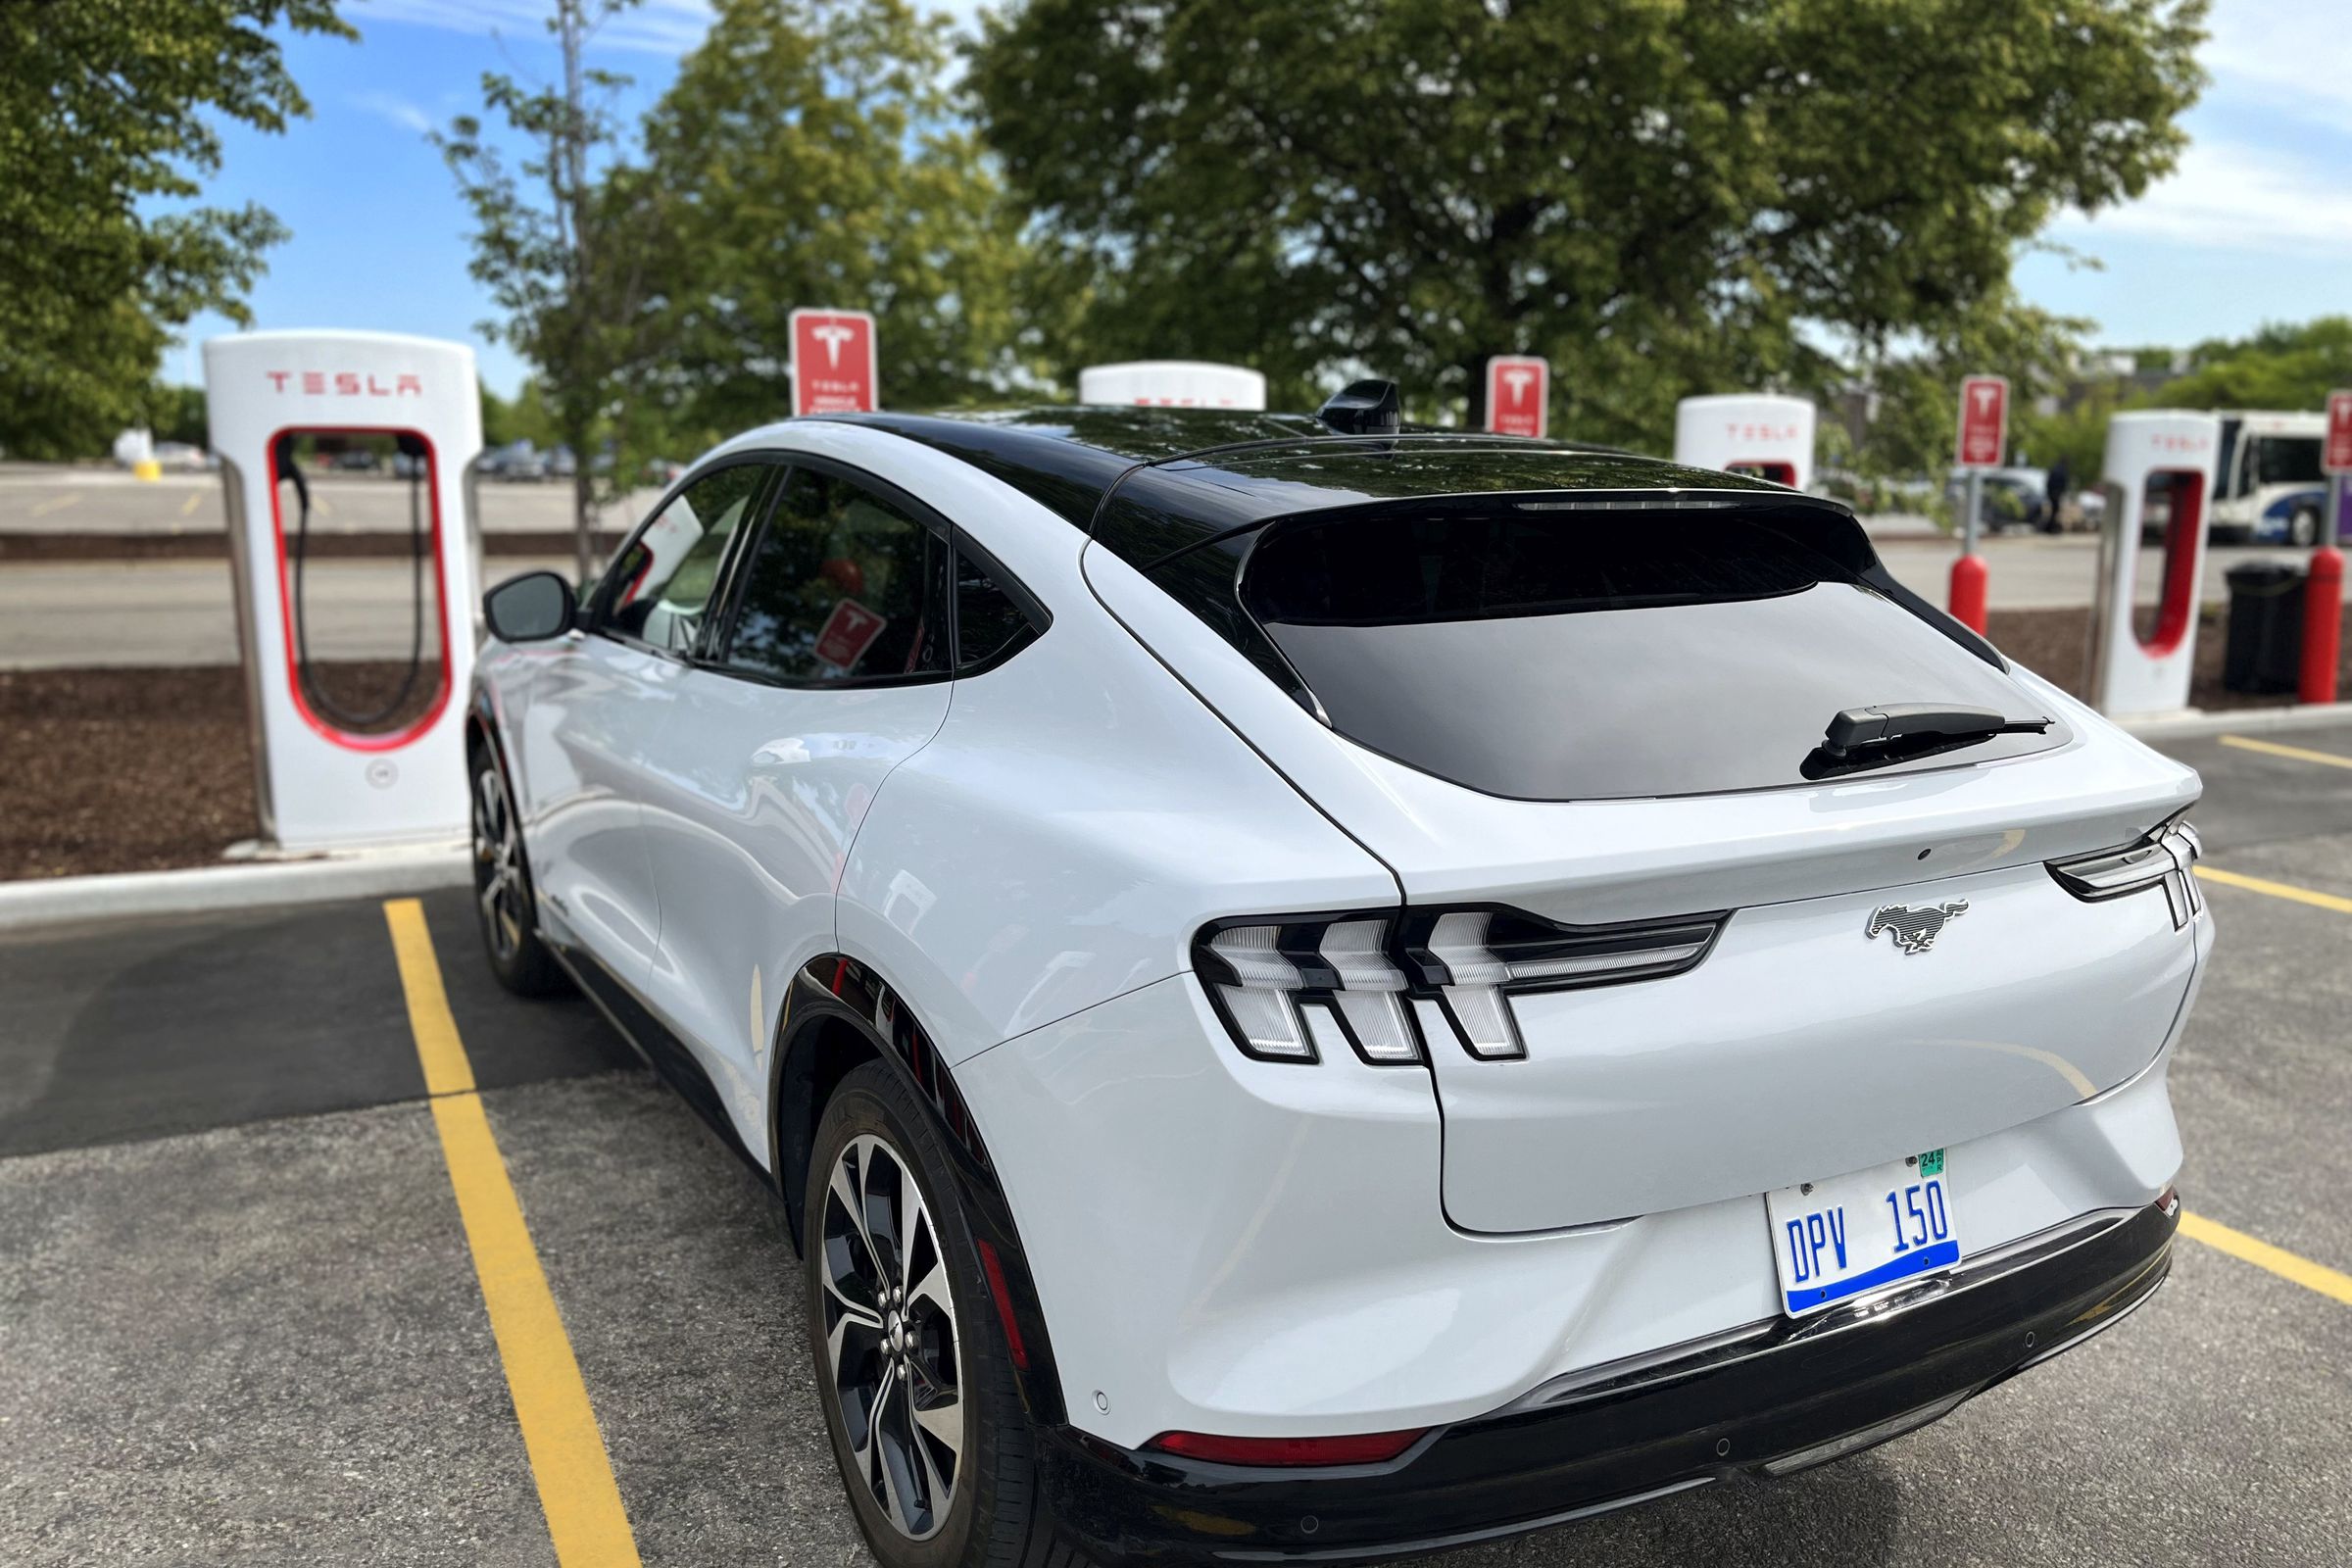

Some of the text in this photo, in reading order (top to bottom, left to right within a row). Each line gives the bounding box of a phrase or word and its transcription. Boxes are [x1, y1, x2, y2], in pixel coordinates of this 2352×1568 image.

[267, 371, 422, 396] TESLA
[1921, 1152, 1936, 1167] 24
[1786, 1180, 1948, 1283] DPV 150
